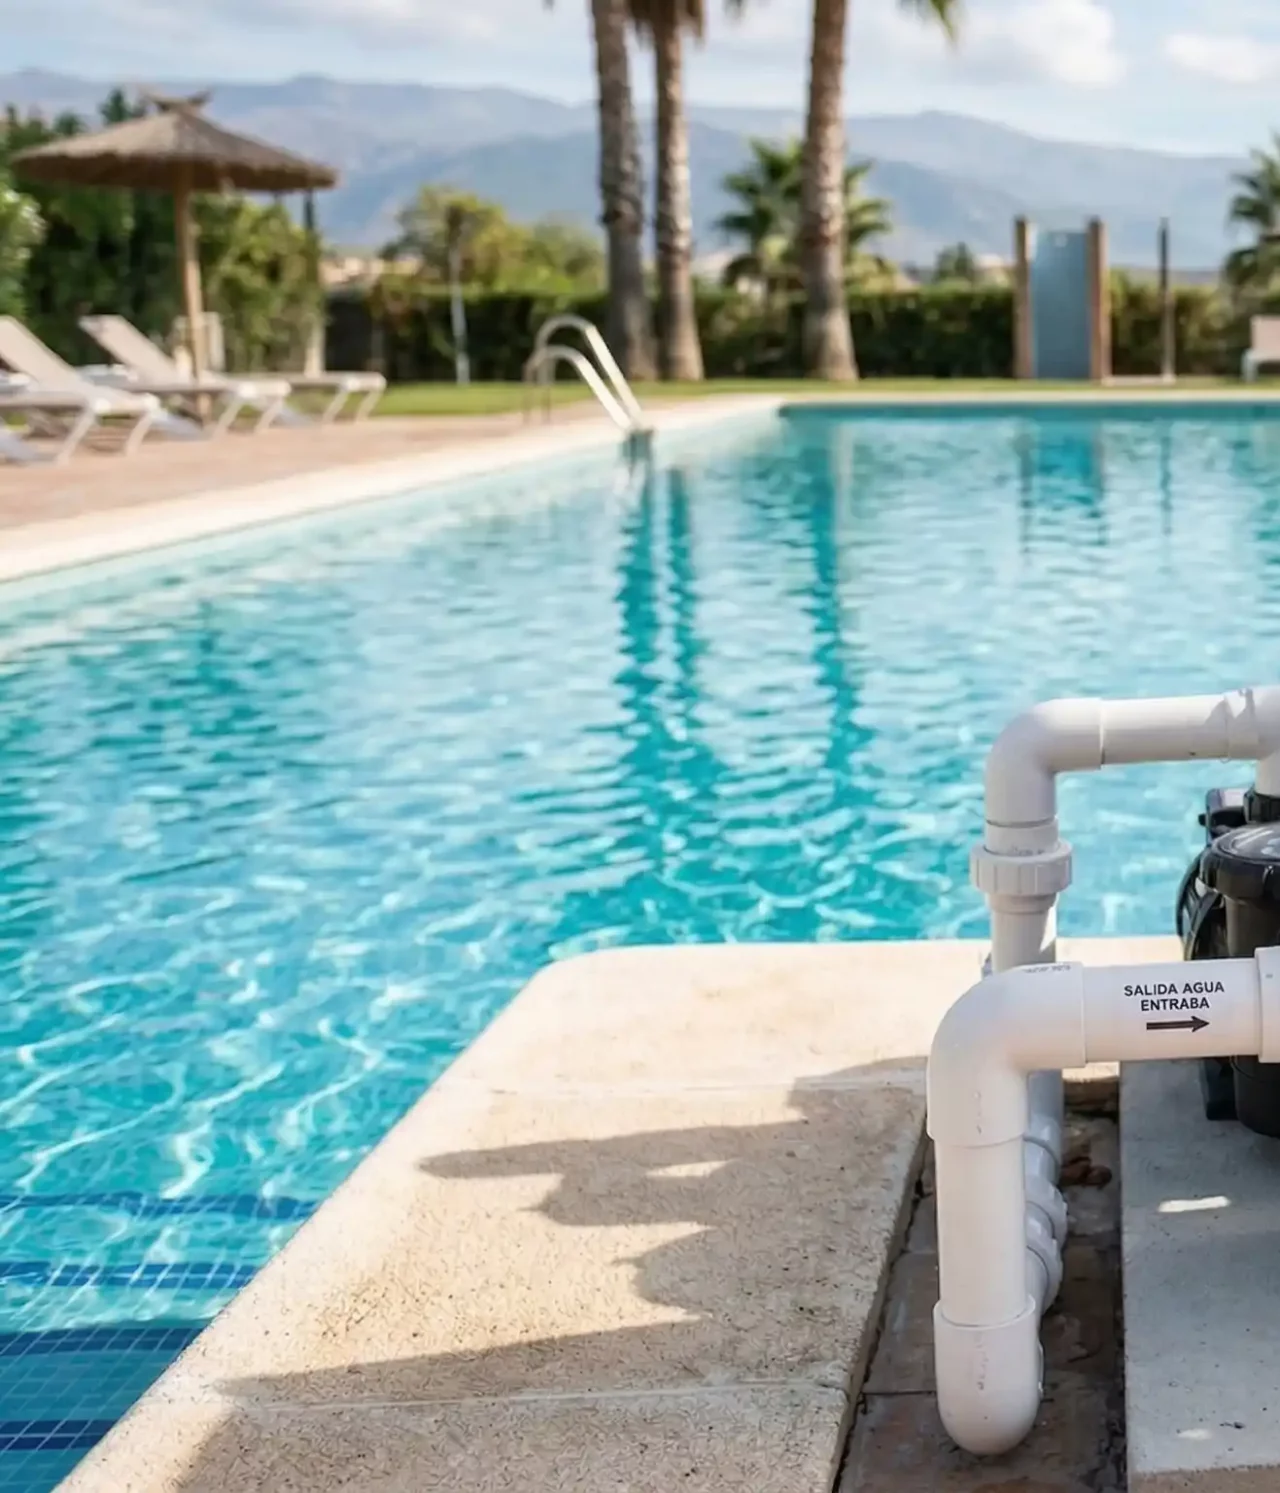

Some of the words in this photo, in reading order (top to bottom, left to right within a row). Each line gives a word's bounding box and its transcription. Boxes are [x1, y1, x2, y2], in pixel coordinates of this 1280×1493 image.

[1123, 983, 1178, 997] SALIDA
[1182, 981, 1225, 994] AGUA
[1141, 996, 1210, 1012] ENTRABA
